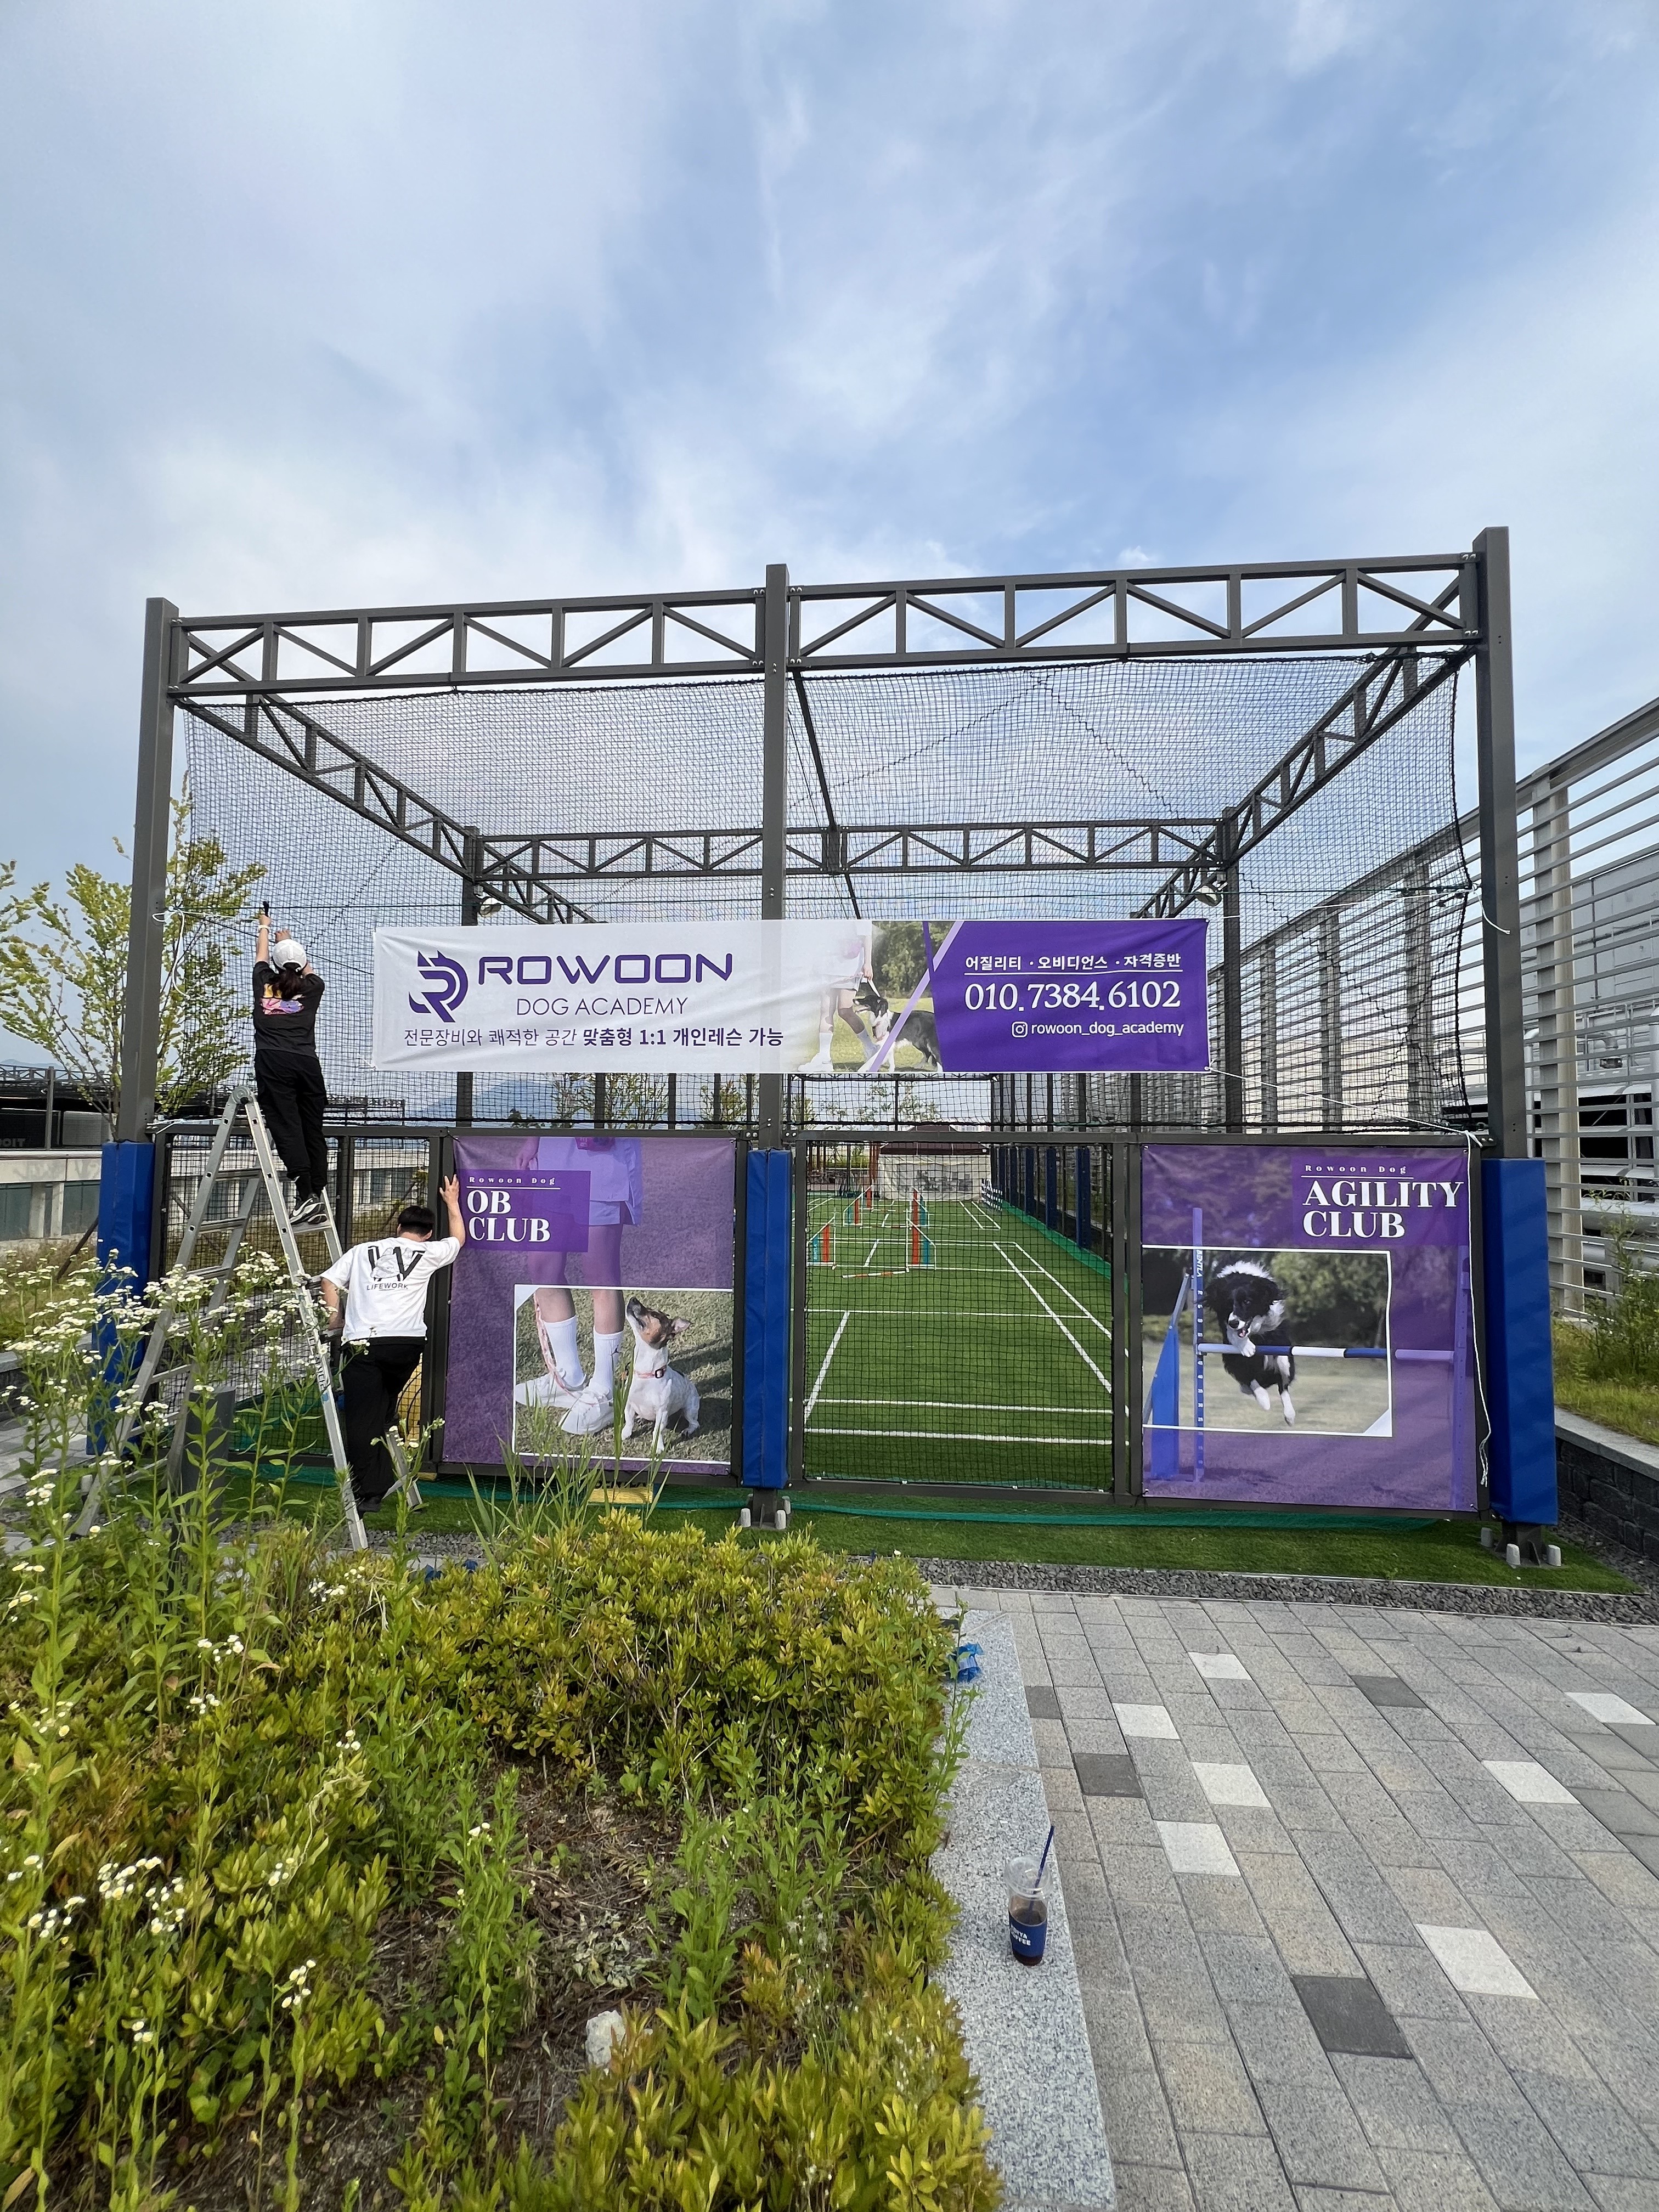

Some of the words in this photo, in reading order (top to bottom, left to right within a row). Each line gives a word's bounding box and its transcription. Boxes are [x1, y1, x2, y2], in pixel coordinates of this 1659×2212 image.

[478, 953, 732, 985] ROWOON
[966, 956, 1021, 970] 어질리티
[965, 980, 1181, 1012] 010.7384.6102
[517, 998, 569, 1015] DOG
[574, 997, 688, 1015] ACADEMY
[404, 1029, 483, 1047] 전문장비와
[489, 1029, 539, 1046] 쾌적한
[545, 1029, 577, 1046] 공간
[583, 1028, 631, 1046] 맞춤형
[640, 1029, 666, 1045] 1:1
[673, 1028, 742, 1047] 개인레슨
[749, 1028, 784, 1046] 가능
[1031, 1021, 1184, 1037] rowoon_dog_academy
[1379, 1166, 1406, 1175] Dog
[532, 1177, 555, 1186] Dog
[467, 1189, 511, 1214] OB
[1302, 1180, 1464, 1207] AGILITY
[469, 1217, 550, 1242] CLUB
[1303, 1210, 1405, 1238] CLUB
[366, 1283, 409, 1291] LIFEWORK
